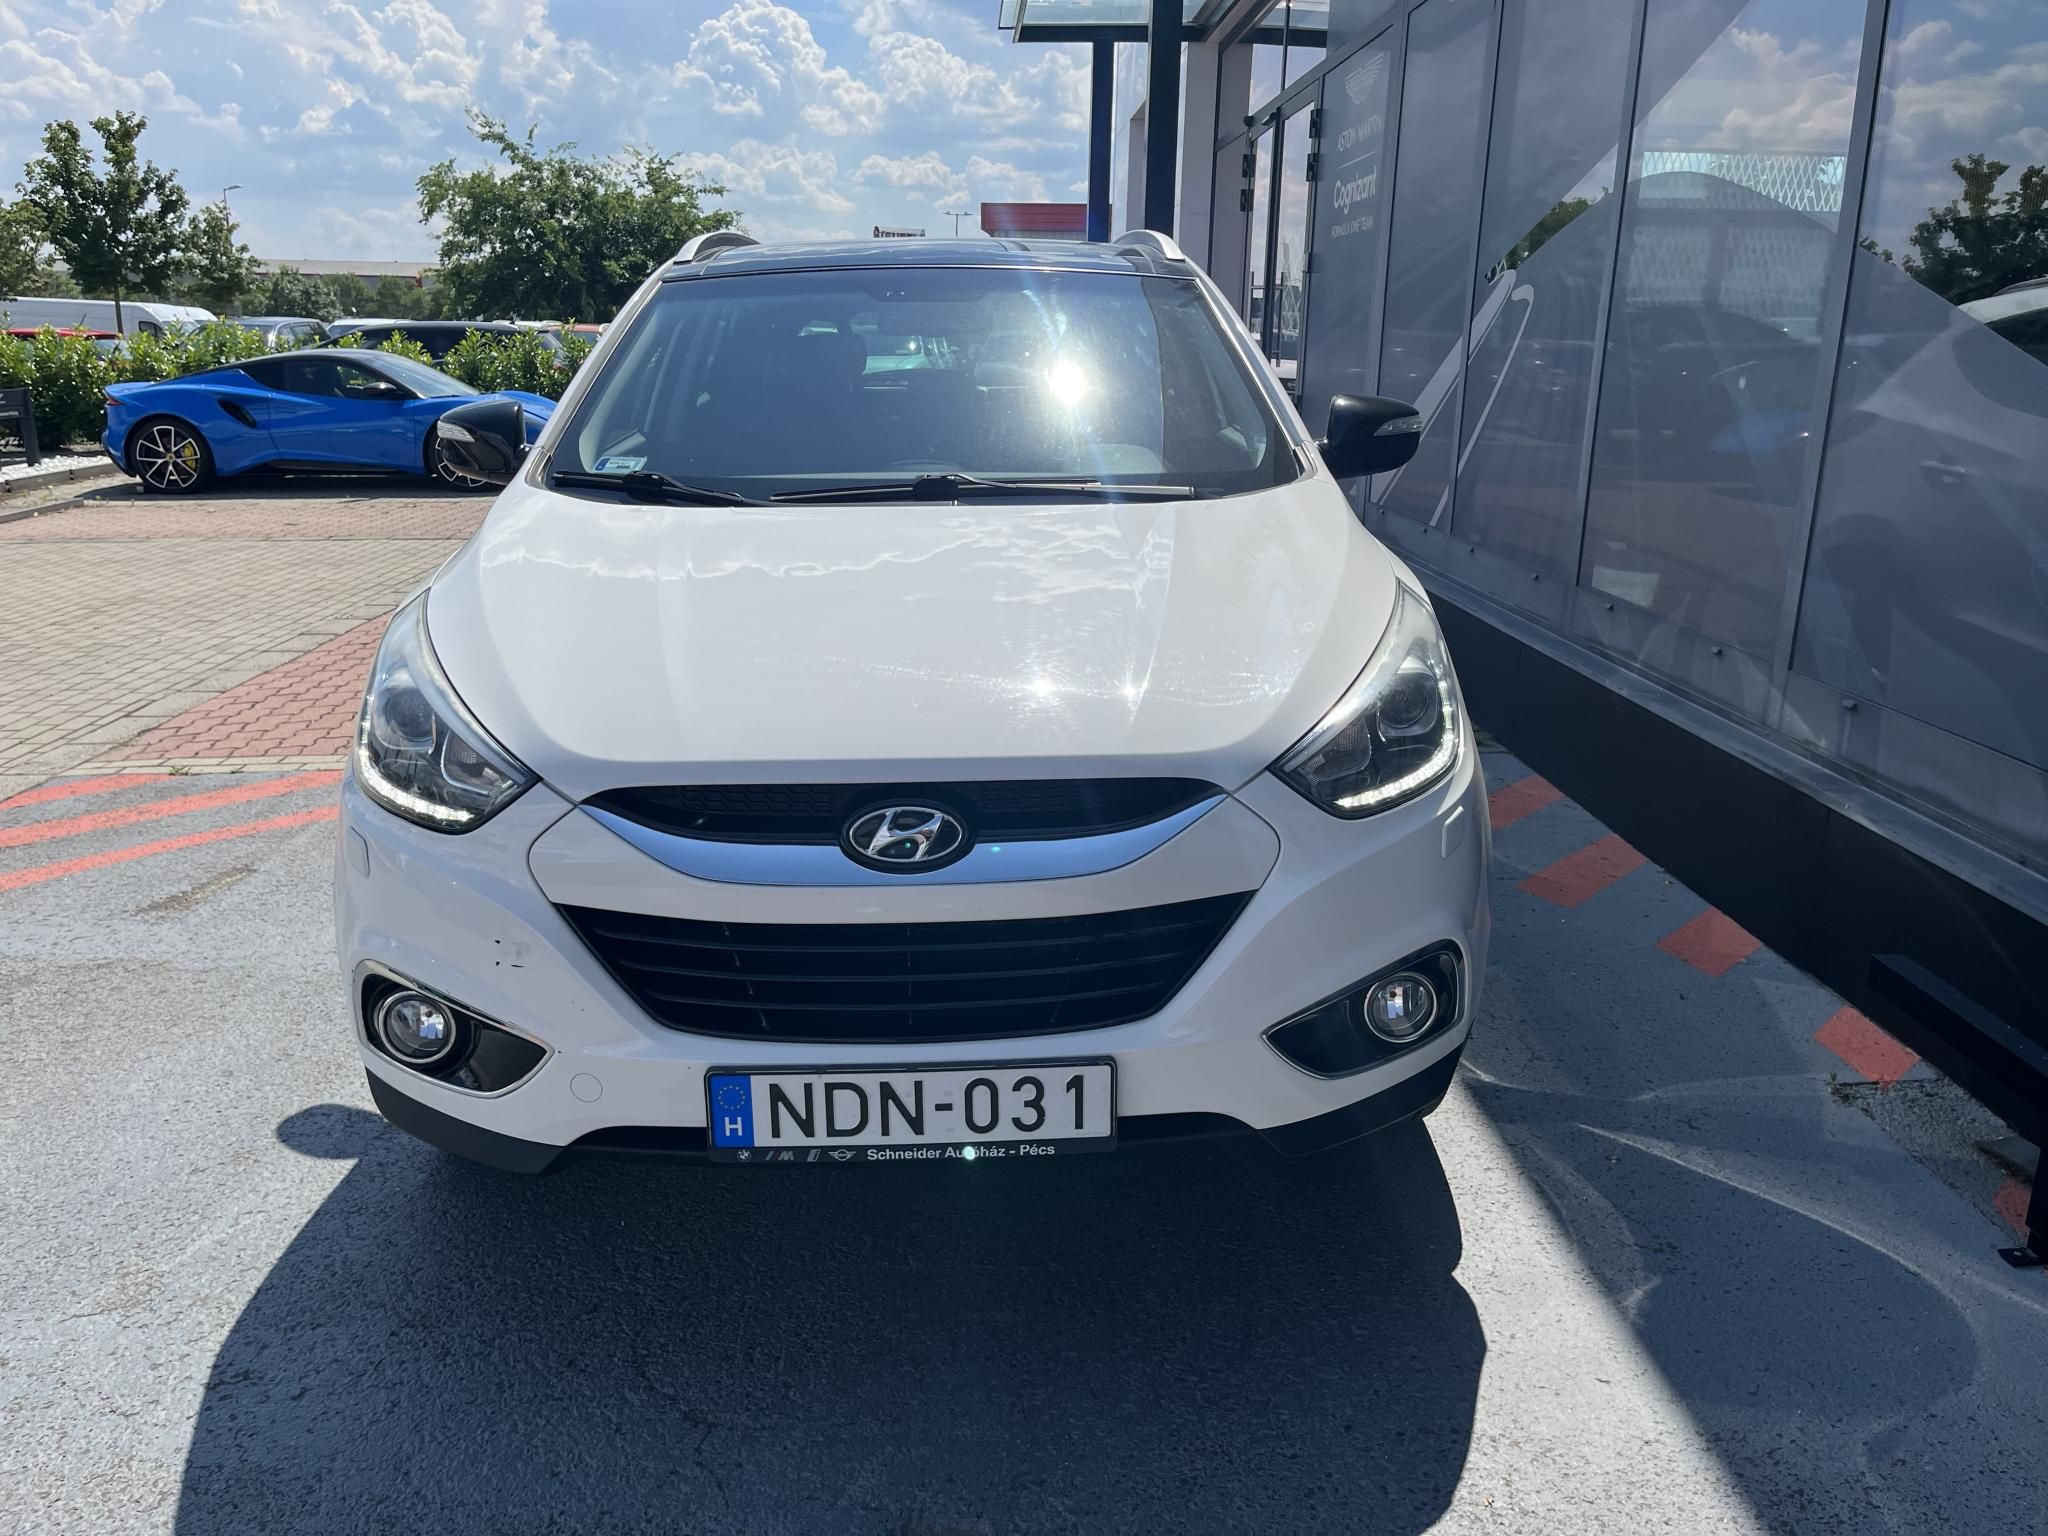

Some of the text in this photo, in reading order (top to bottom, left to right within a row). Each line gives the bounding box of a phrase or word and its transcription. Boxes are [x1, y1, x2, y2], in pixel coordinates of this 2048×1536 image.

[1337, 113, 1382, 152] ASTON MARTIN
[1333, 165, 1377, 215] Cognizant
[768, 1074, 1084, 1139] NDN-031
[724, 1116, 743, 1137] H
[867, 1148, 942, 1161] Schneider
[945, 1145, 1006, 1159] Auóház
[1019, 1143, 1055, 1156] Pécs
